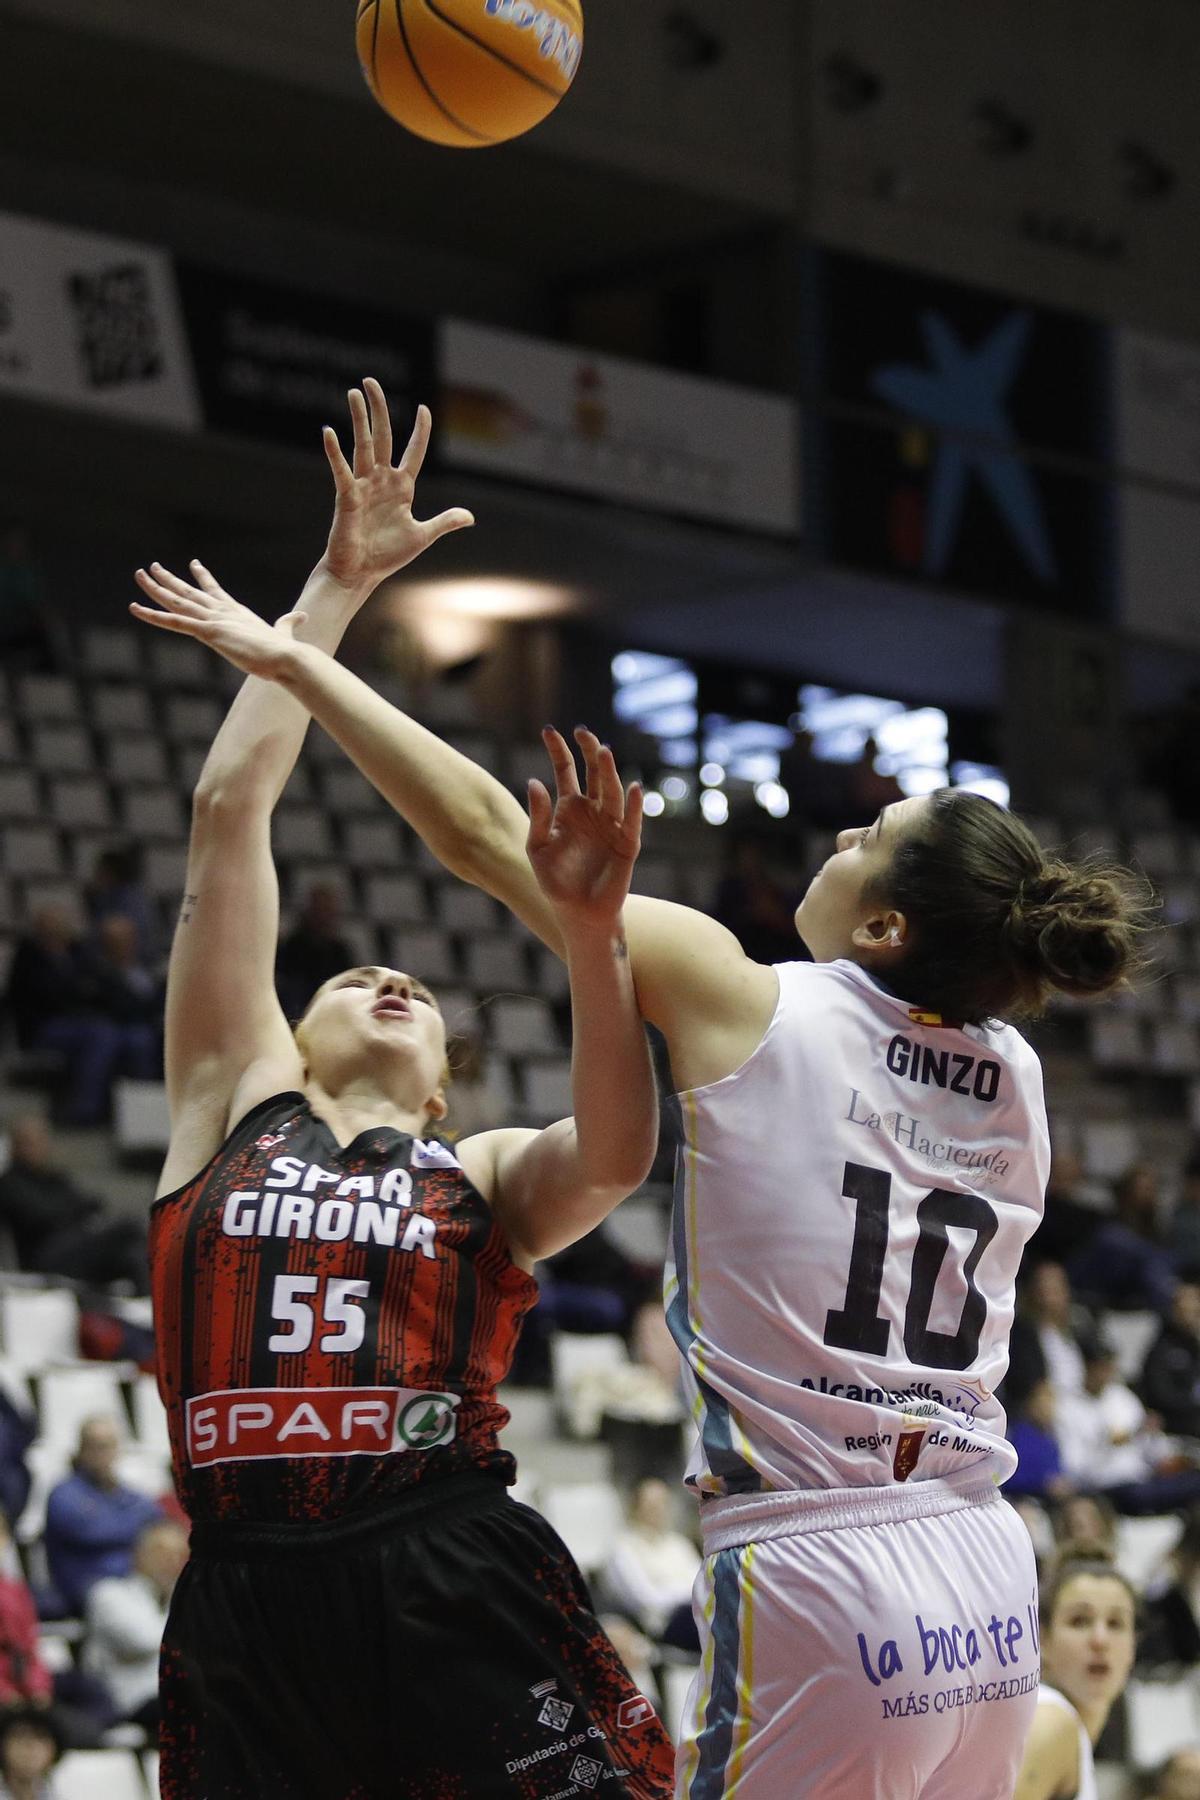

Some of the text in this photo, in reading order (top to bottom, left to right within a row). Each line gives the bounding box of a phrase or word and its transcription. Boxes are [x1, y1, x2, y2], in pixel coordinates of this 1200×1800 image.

[887, 1034, 1001, 1102] GINZO
[845, 1088, 882, 1130] La
[894, 1111, 1010, 1176] Hacienda
[265, 1156, 413, 1207] SPAR
[222, 1191, 437, 1260] GIRONA
[823, 1161, 999, 1371] 10
[268, 1275, 371, 1353] 55
[800, 1377, 945, 1407] Alcantarilla
[194, 1400, 390, 1451] SPAR
[845, 1430, 892, 1451] Regin
[928, 1430, 949, 1447] de
[857, 1632, 903, 1687] la
[916, 1614, 982, 1676] boca
[988, 1614, 1023, 1667] te
[882, 1691, 929, 1719] MÁS
[934, 1688, 965, 1714] QUE
[505, 1738, 568, 1774] Diputació
[569, 1733, 586, 1747] de
